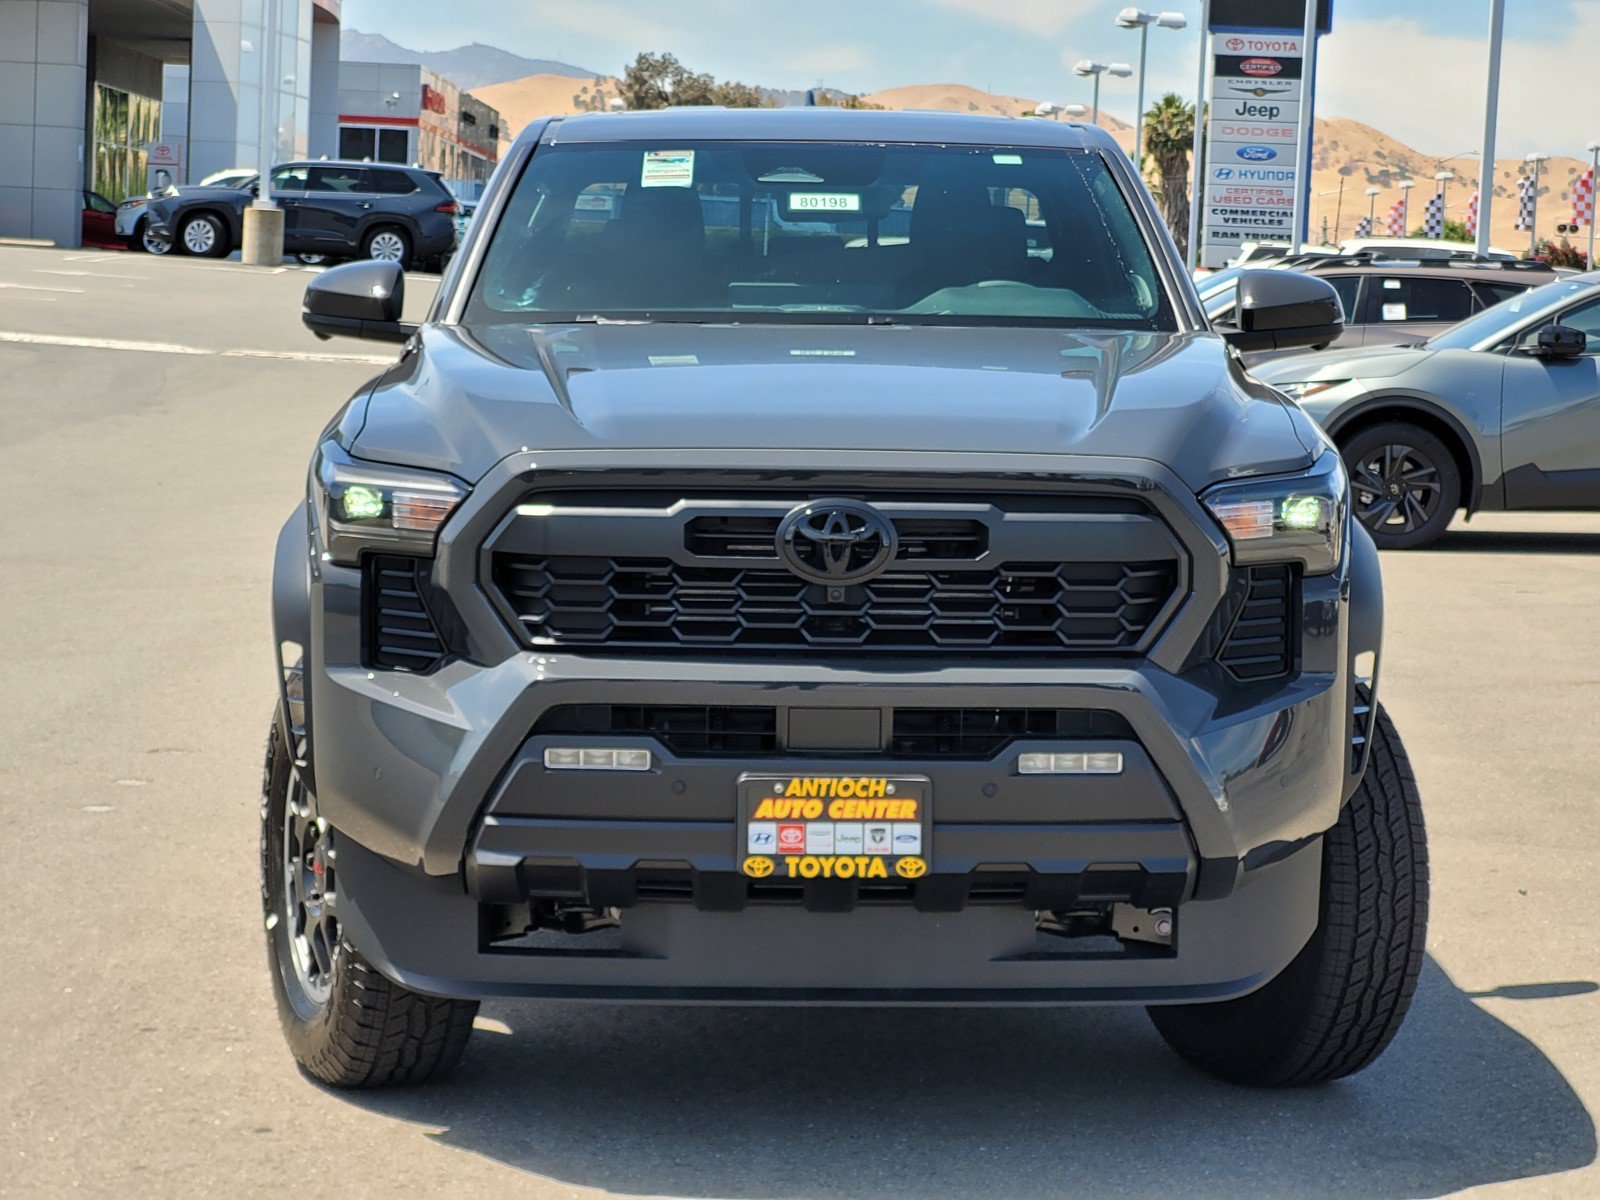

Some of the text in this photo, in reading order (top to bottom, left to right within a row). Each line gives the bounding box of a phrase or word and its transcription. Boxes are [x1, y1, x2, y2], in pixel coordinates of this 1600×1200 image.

[1248, 41, 1297, 52] TOYOTA
[1235, 101, 1280, 120] Jeep
[1222, 127, 1293, 137] DODGE
[1243, 148, 1269, 159] Ford
[1238, 170, 1295, 181] HYUNDA
[1225, 187, 1284, 196] CERTIFIED
[800, 197, 848, 208] 80198
[1212, 196, 1294, 206] USED CARS
[1223, 217, 1284, 226] VEHICLES
[1211, 231, 1240, 239] RAM
[785, 778, 886, 798] ANTIOCH
[753, 798, 918, 820] AUTO CENTER
[784, 856, 888, 879] TOYOTA
